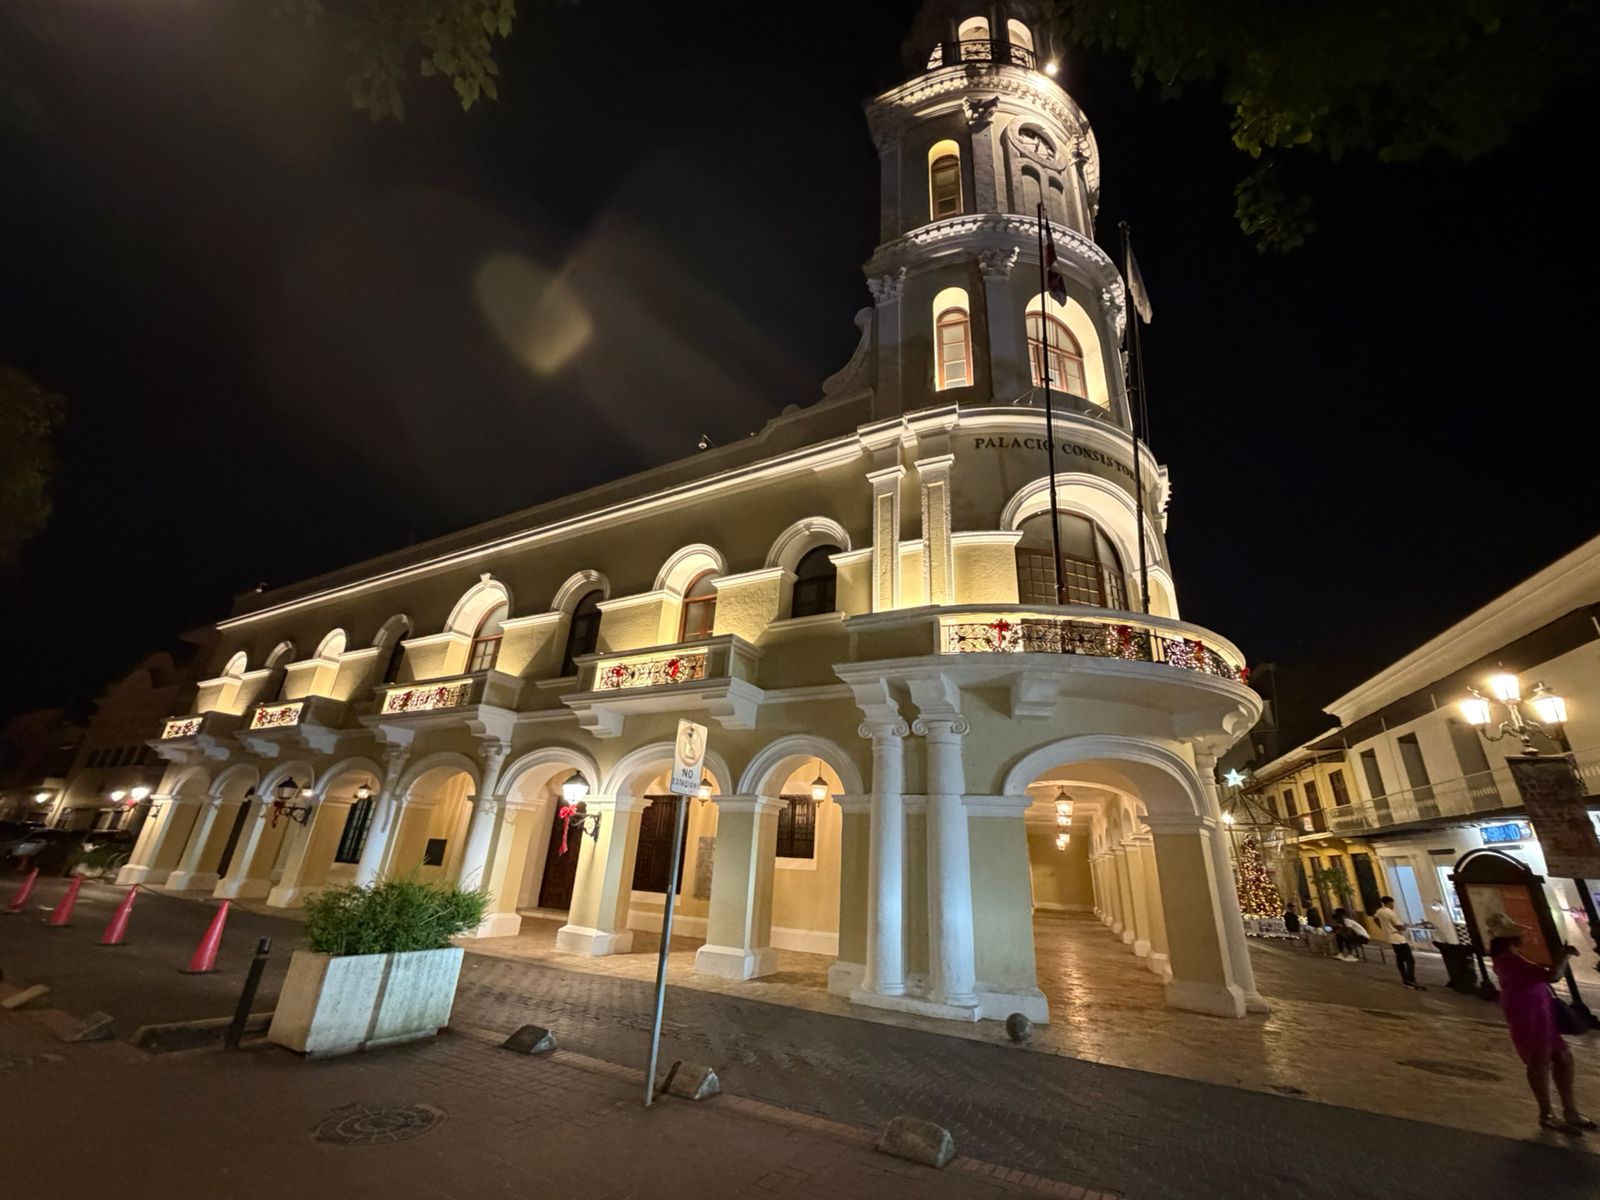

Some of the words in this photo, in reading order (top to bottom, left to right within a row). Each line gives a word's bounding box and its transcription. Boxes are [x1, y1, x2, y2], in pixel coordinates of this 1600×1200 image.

[975, 437, 1055, 451] PALACIO
[1062, 443, 1145, 491] CONSISTOR
[682, 768, 694, 779] NO
